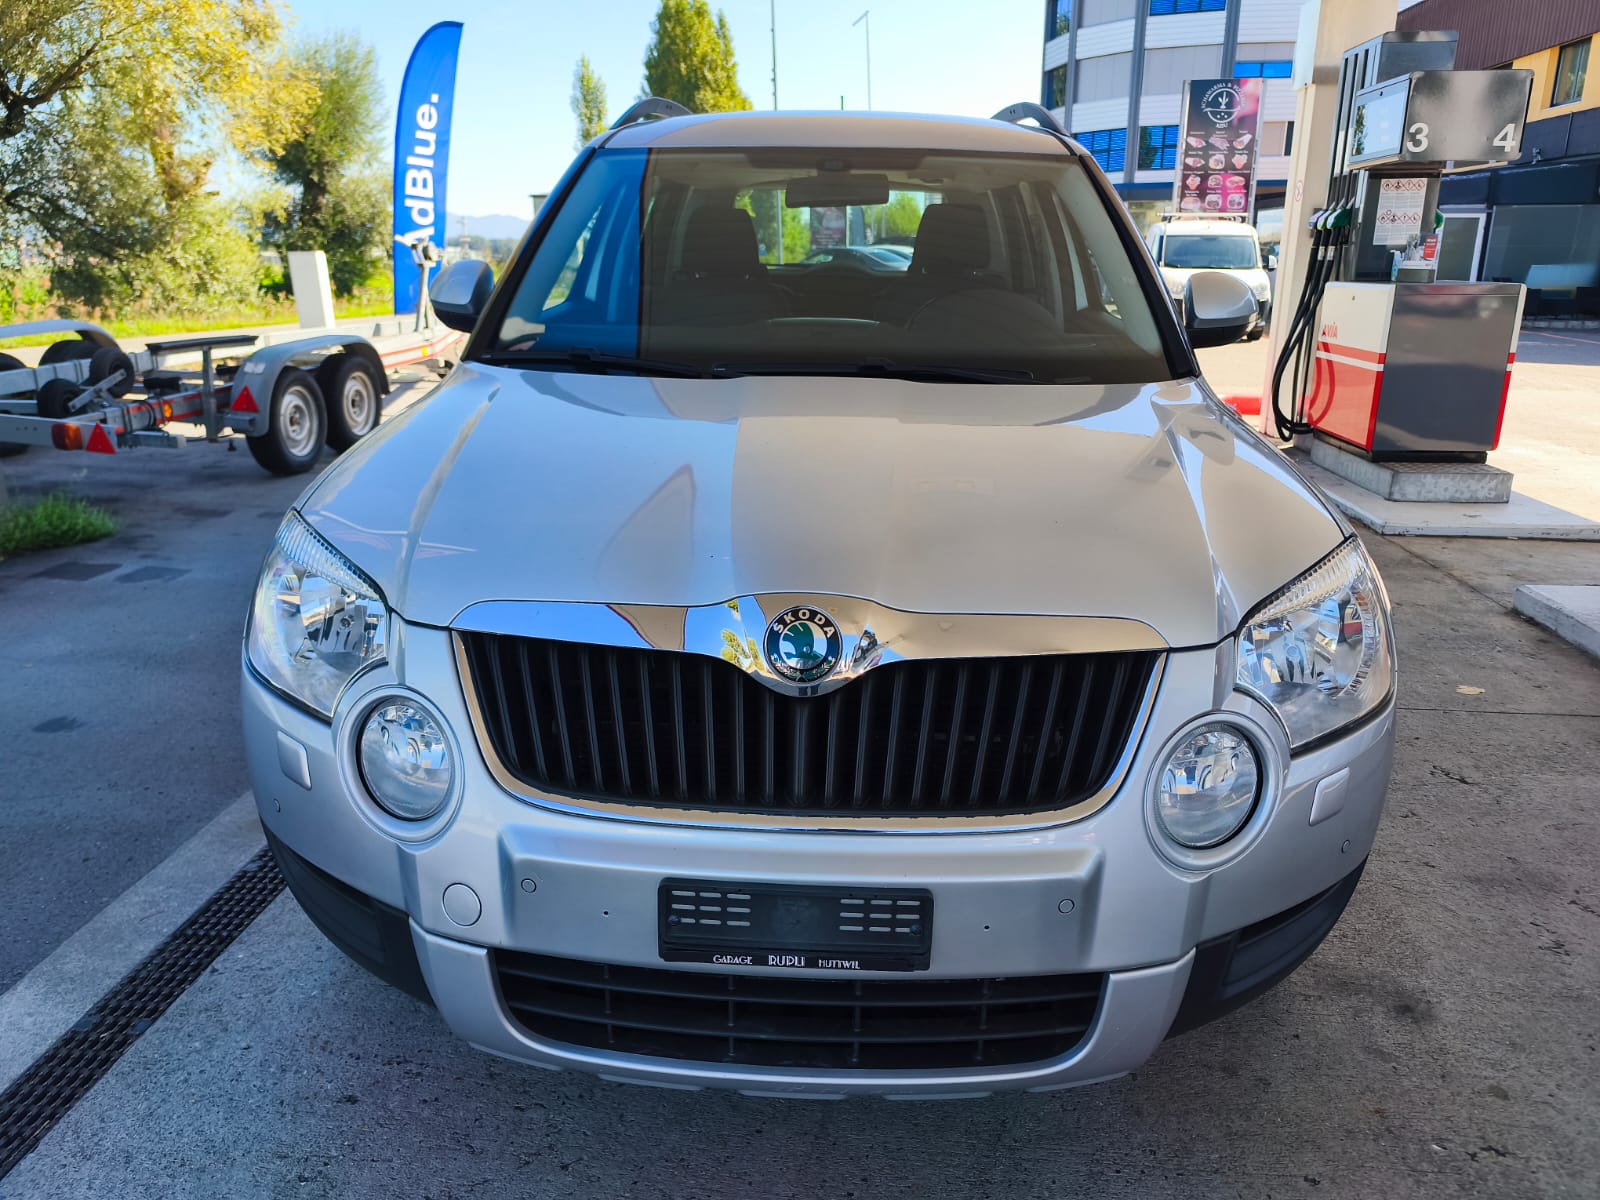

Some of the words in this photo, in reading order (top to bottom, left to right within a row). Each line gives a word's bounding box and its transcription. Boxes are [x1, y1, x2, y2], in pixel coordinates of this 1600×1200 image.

[1406, 122, 1429, 153] 3
[1492, 123, 1516, 152] 4
[712, 954, 753, 965] GARAGE
[768, 954, 806, 967] RUPLI
[818, 959, 861, 970] HUTTWIL
